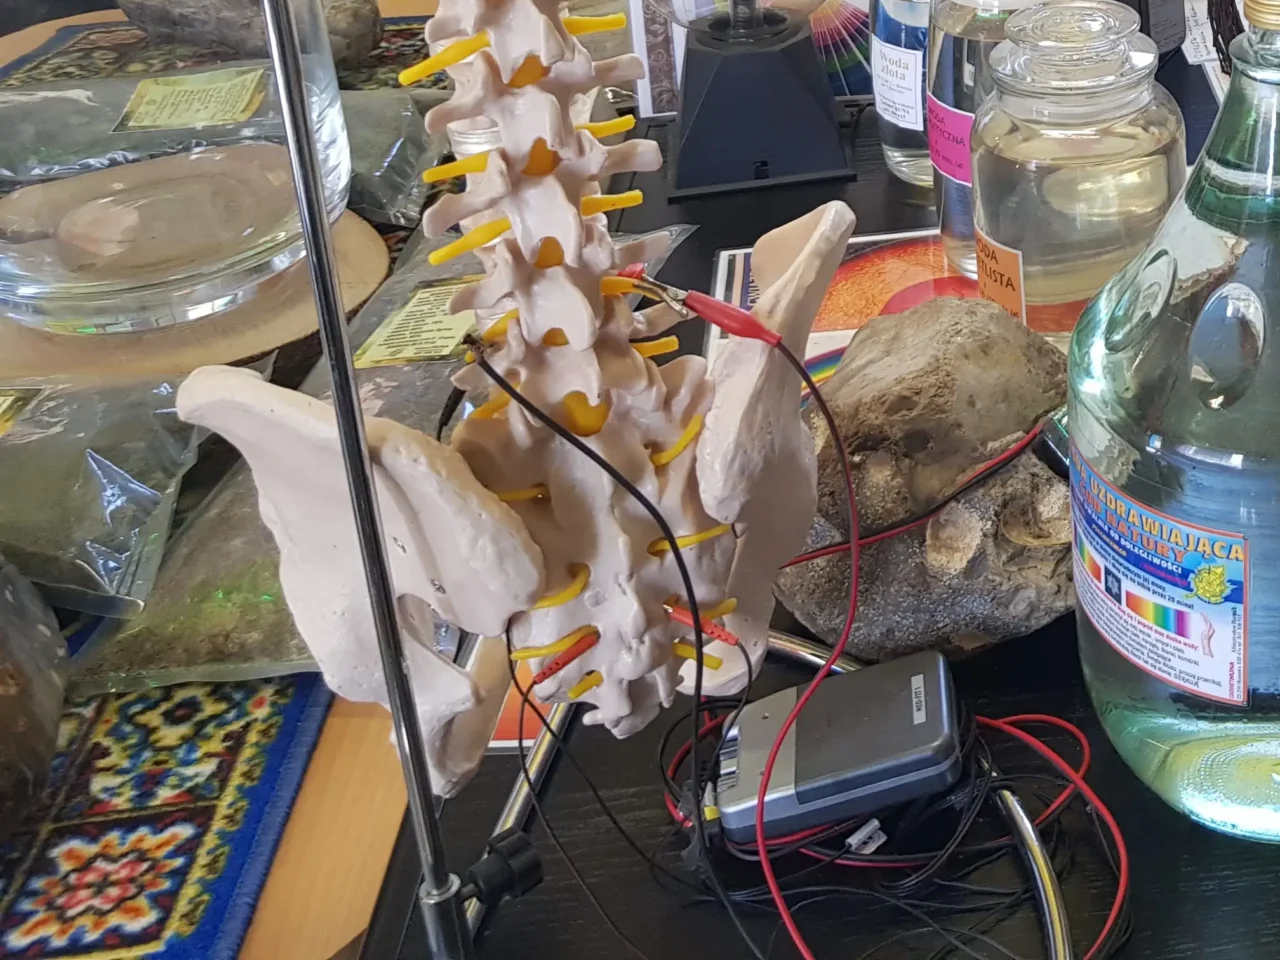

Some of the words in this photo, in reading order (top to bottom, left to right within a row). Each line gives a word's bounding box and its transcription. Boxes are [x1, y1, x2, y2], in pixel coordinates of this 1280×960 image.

[880, 51, 909, 70] Woda
[1090, 476, 1244, 561] UZDRAWIAJĄCA
[1105, 509, 1190, 564] NATURY
